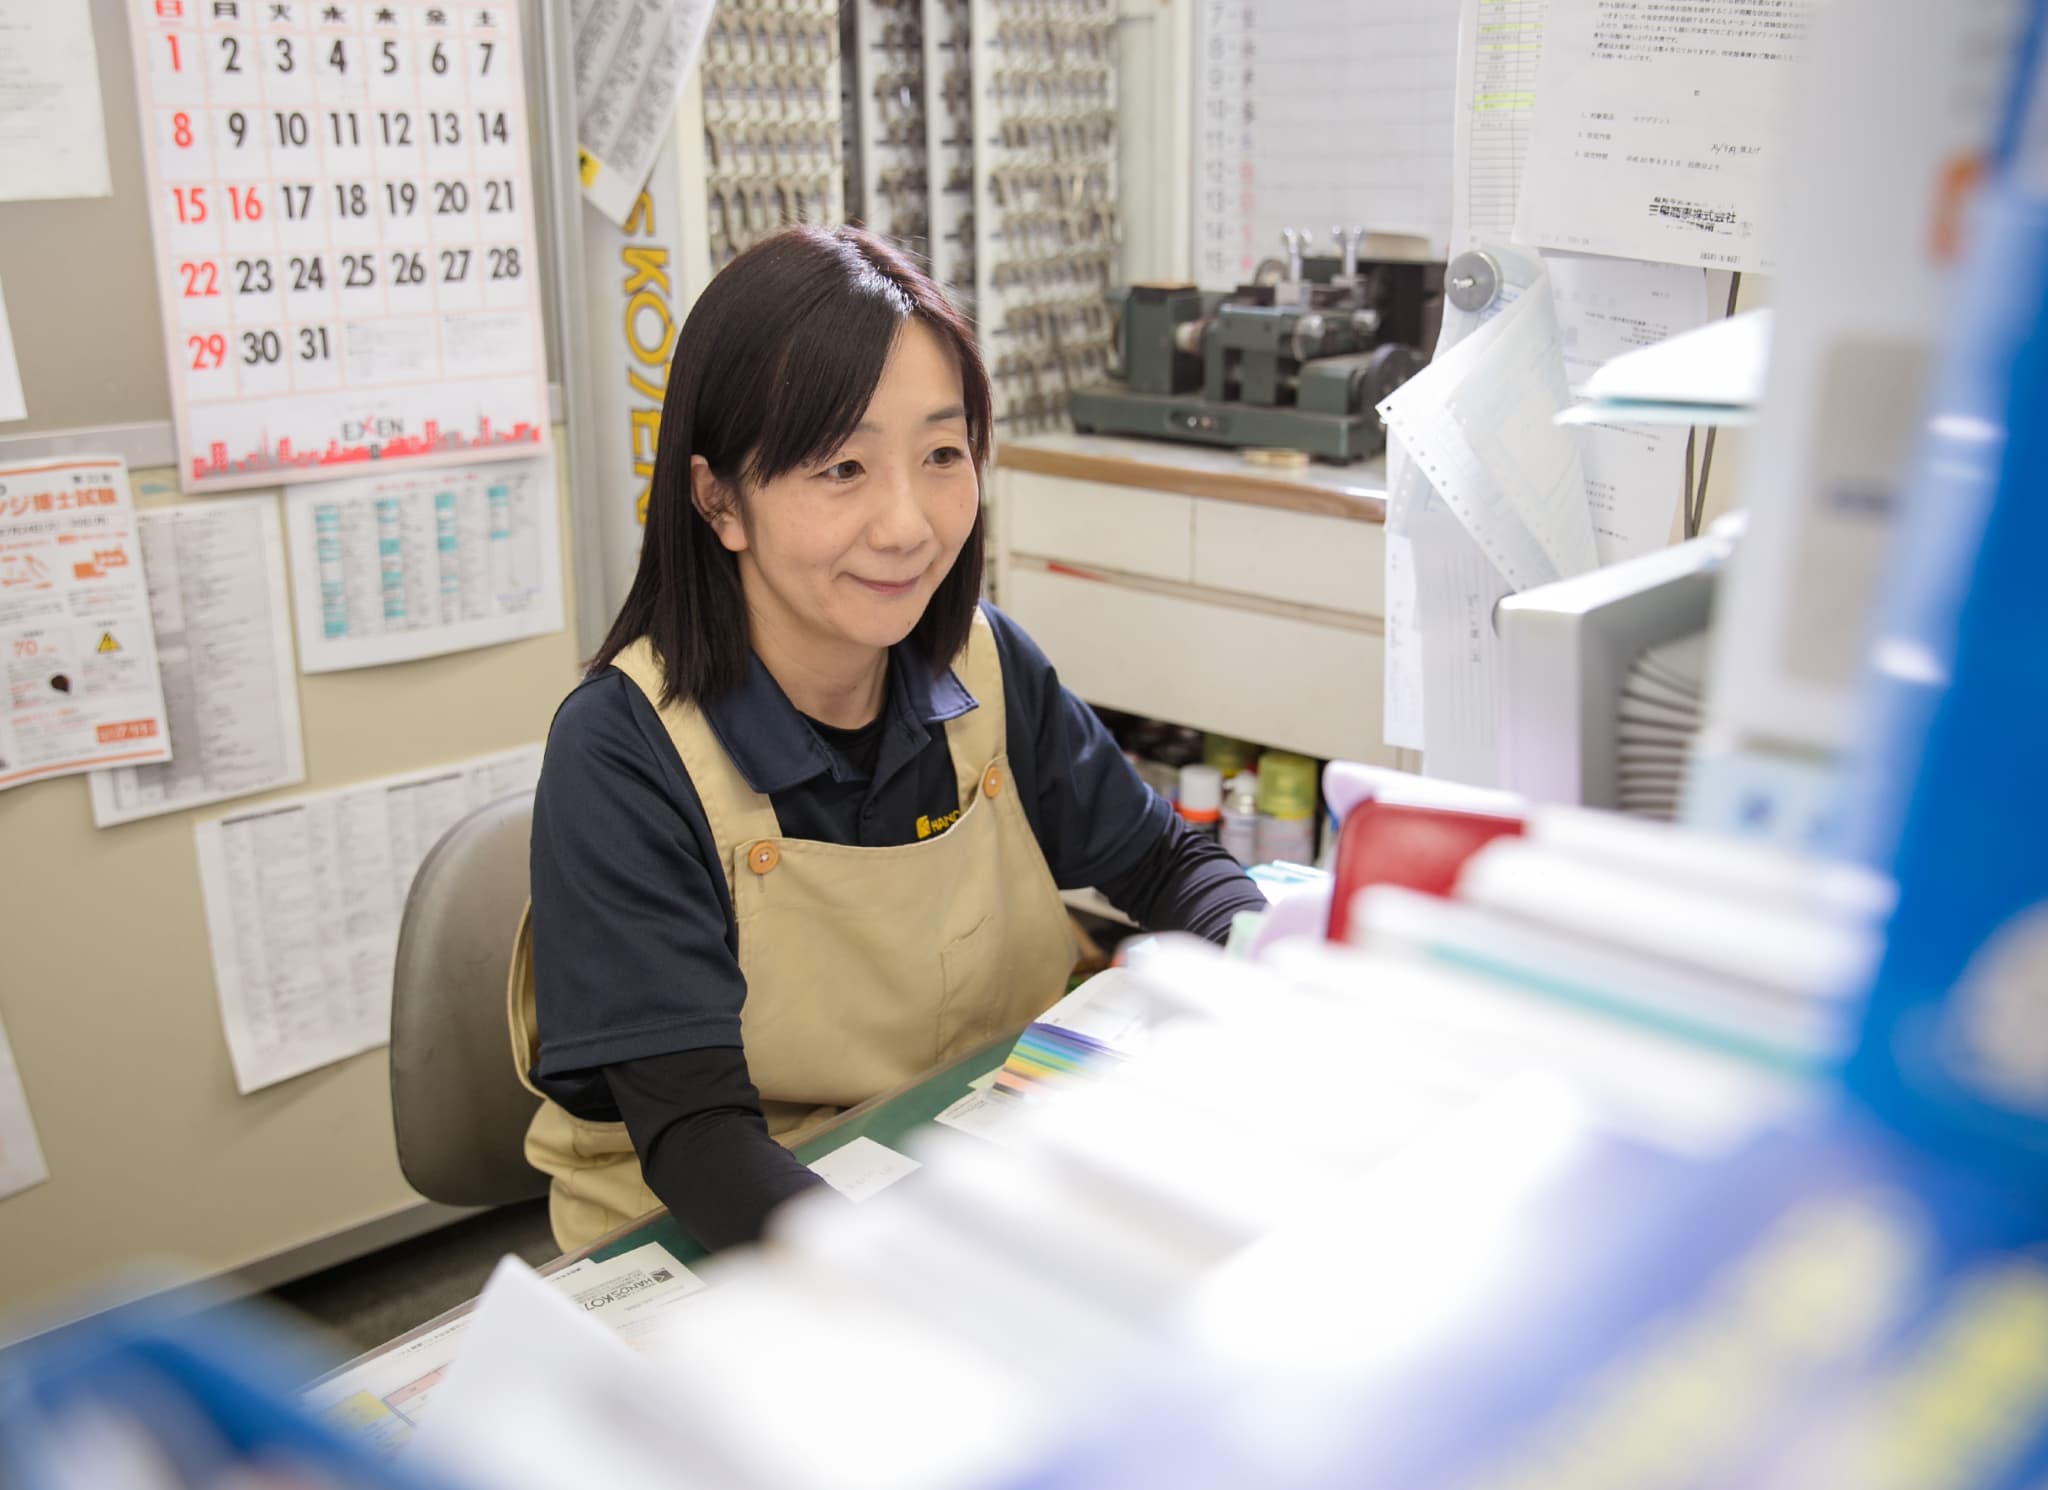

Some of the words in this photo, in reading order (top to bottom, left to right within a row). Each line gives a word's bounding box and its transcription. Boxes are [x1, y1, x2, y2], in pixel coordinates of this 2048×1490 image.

[213, 1, 238, 19] 月
[269, 3, 291, 22] 火
[166, 34, 181, 73] 1
[221, 36, 241, 73] 2
[276, 37, 294, 73] 3
[329, 39, 347, 74] 4
[383, 40, 398, 75] 5
[431, 42, 448, 75] 6
[479, 42, 494, 76] 7
[172, 111, 193, 149] 8
[228, 111, 247, 148] 9
[274, 111, 308, 147] 10
[329, 111, 359, 147] 11
[379, 111, 411, 146] 12
[429, 111, 460, 145] 13
[478, 111, 508, 144] 14
[172, 187, 207, 223] 15
[227, 186, 263, 221] 16
[282, 184, 313, 220] 17
[335, 183, 367, 217] 18
[385, 181, 417, 216] 19
[434, 181, 469, 215] 20
[485, 180, 517, 213] 21
[180, 261, 219, 297] 22
[235, 259, 273, 295] 23
[289, 256, 325, 291] 24
[341, 254, 376, 288] 25
[391, 252, 426, 285] 26
[441, 248, 471, 283] 27
[489, 248, 521, 280] 28
[188, 333, 226, 370] 29
[242, 330, 281, 365] 30
[299, 326, 329, 361] 31
[341, 415, 404, 442] EXEN
